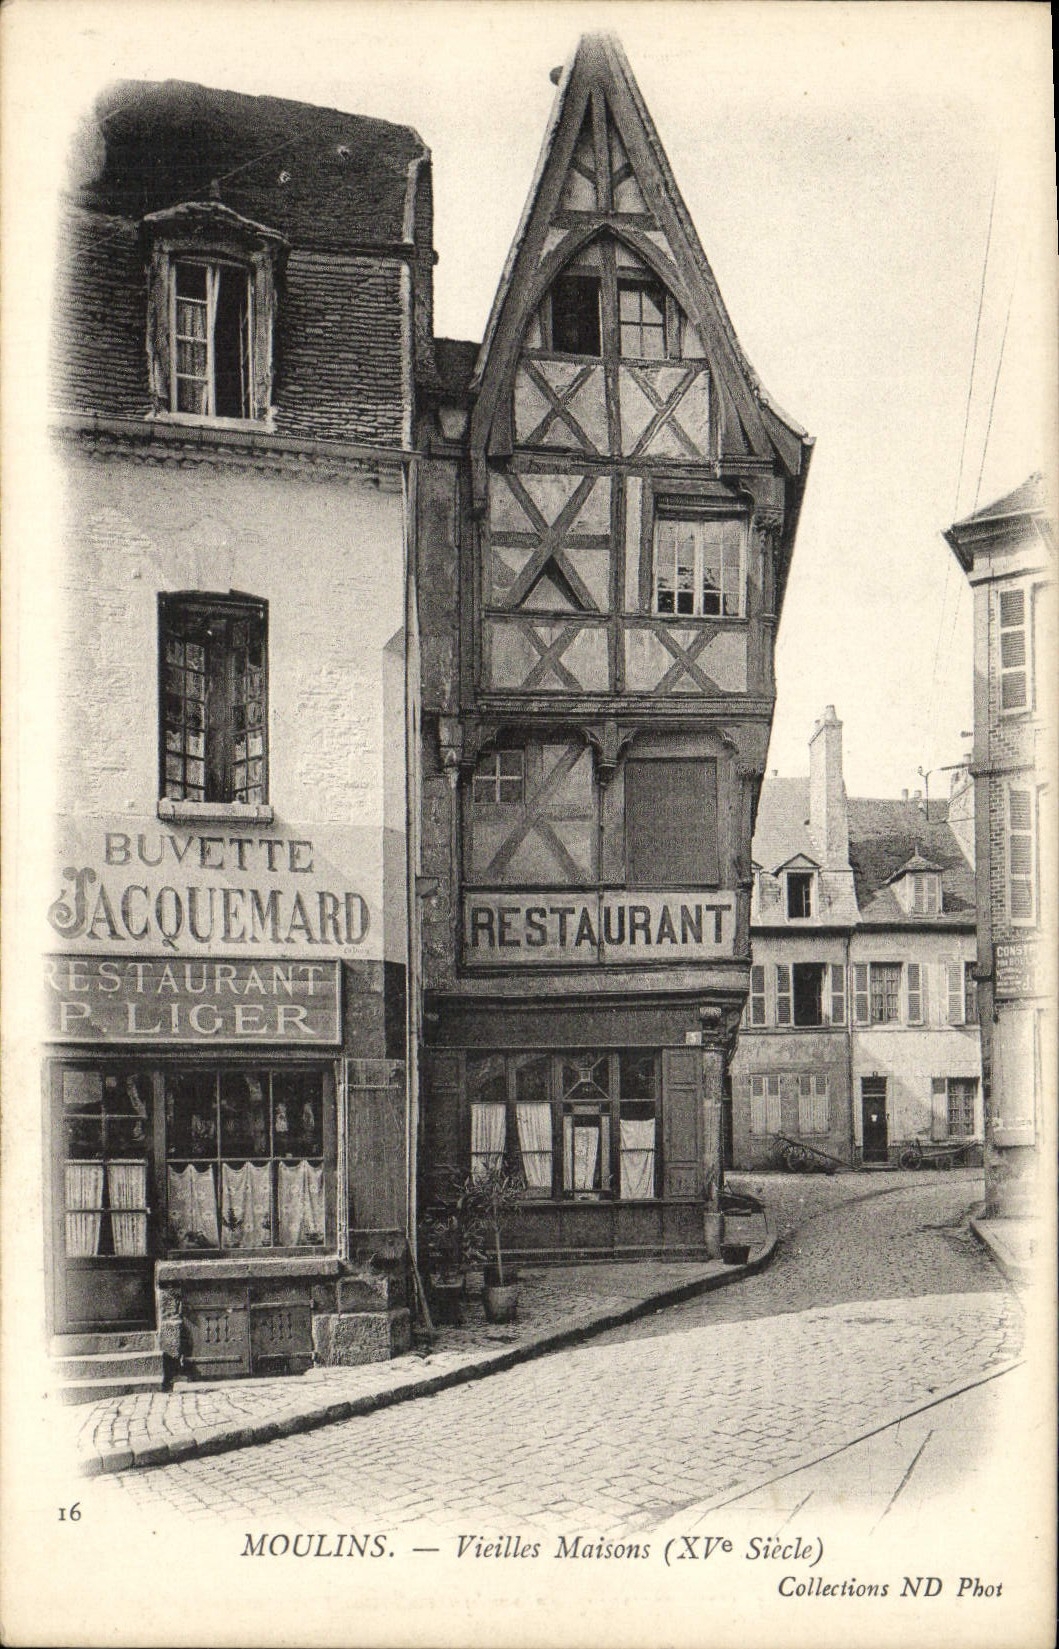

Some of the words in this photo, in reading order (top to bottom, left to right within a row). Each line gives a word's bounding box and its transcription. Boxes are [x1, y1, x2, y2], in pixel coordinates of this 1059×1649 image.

[104, 832, 314, 873] BUVETTE
[48, 866, 372, 951] JACQUEMARD
[472, 904, 732, 948] RESTAURANT
[127, 1002, 316, 1035] LIGER
